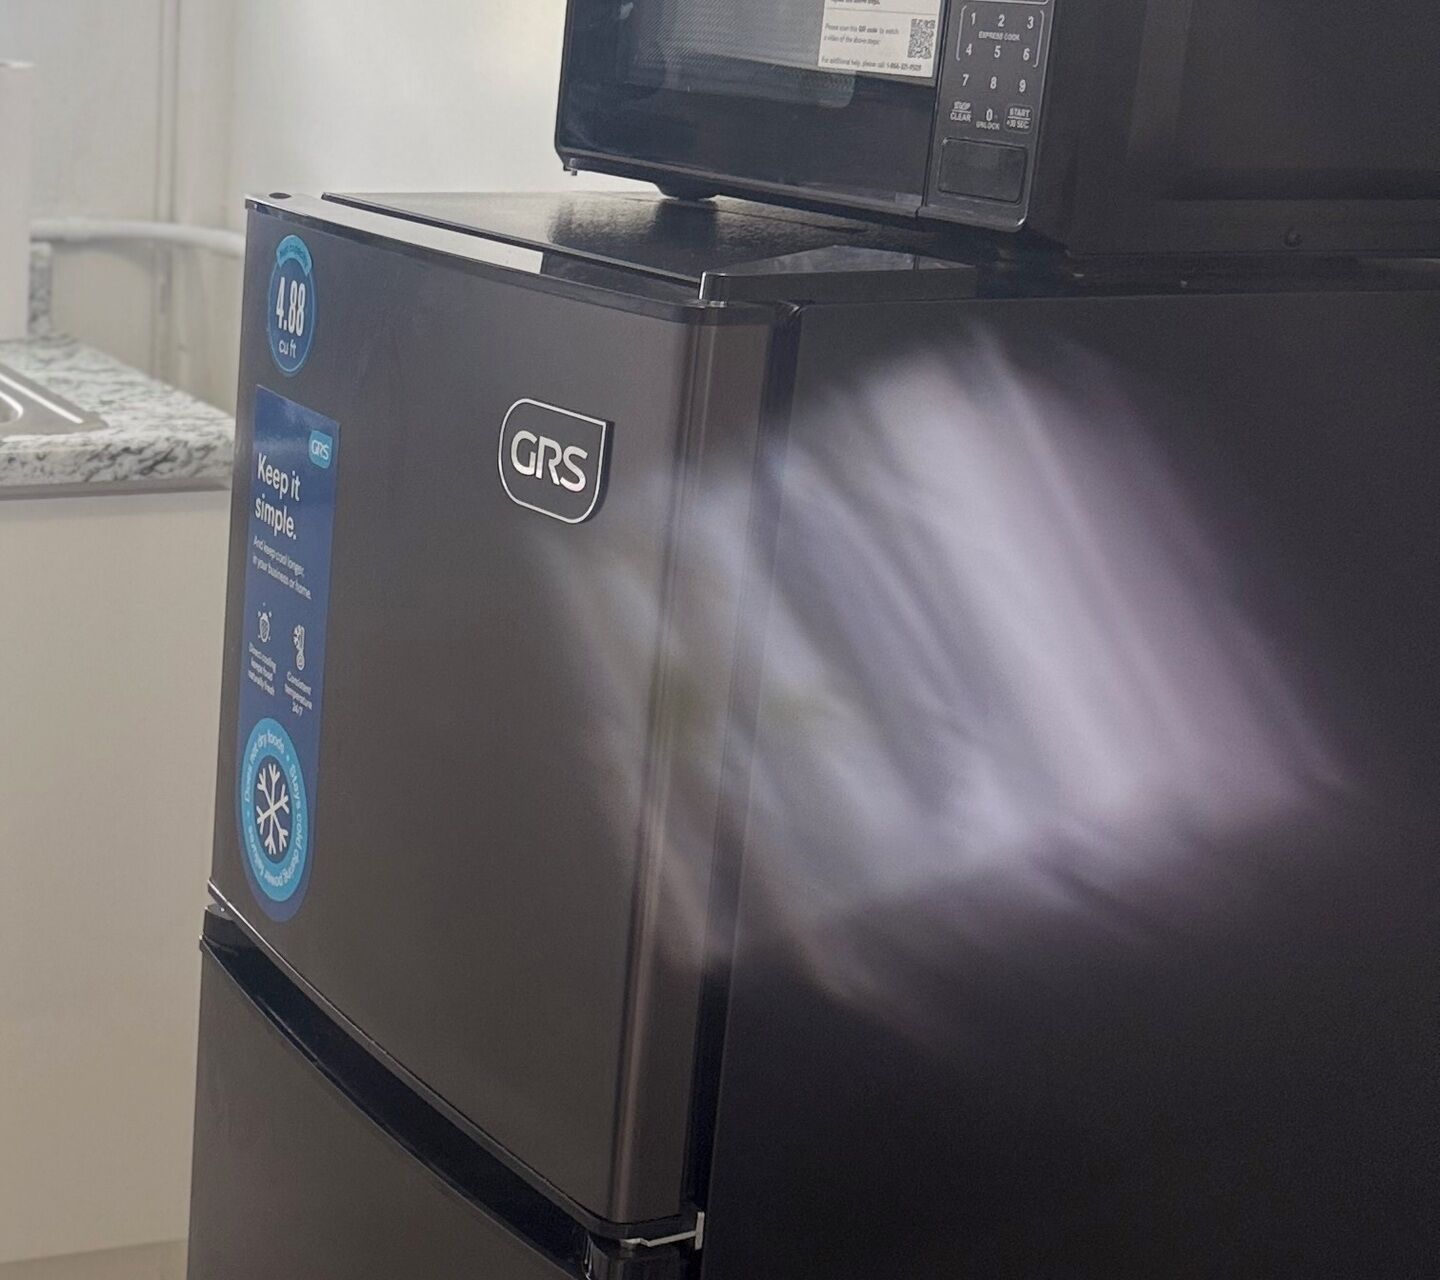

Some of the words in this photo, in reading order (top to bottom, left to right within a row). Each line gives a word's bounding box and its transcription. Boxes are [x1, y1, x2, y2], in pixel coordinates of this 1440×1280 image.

[971, 12, 976, 26] 1
[997, 14, 1006, 27] 2
[1026, 15, 1034, 29] 3
[978, 31, 1004, 41] EXPRESS
[965, 43, 973, 56] 4
[993, 45, 1001, 58] 5
[1023, 47, 1031, 61] 6
[962, 73, 970, 87] 7
[990, 76, 997, 90] 8
[1019, 79, 1026, 93] 9
[950, 112, 972, 122] CLEAR
[986, 108, 993, 121] 0
[1009, 107, 1031, 117] START
[975, 121, 1000, 130] UNLOCK
[1017, 120, 1030, 129] SEC
[276, 276, 306, 337] 4.88
[278, 339, 289, 355] cu
[289, 339, 297, 359] ft
[311, 439, 330, 460] GRS
[511, 430, 588, 492] GRS
[257, 452, 289, 500] Keep
[291, 470, 301, 502] it
[255, 493, 297, 540] simple.
[295, 813, 303, 851] cold
